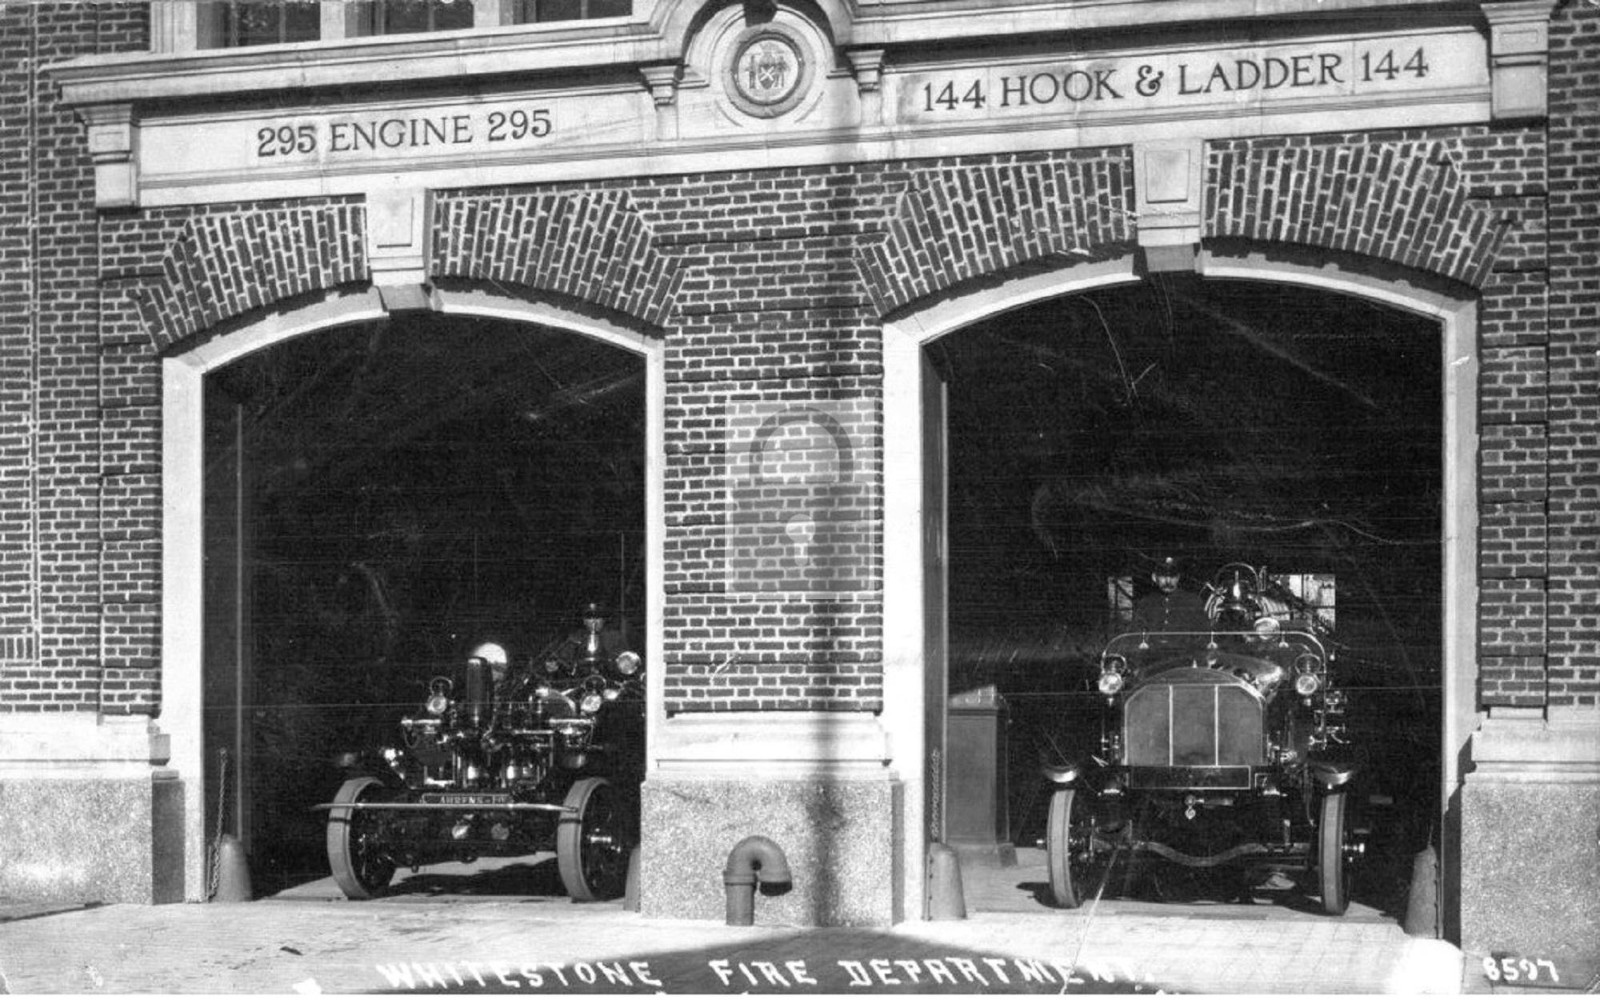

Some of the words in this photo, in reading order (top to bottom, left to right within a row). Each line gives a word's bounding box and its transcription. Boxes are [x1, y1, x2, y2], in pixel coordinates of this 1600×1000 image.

[923, 80, 986, 111] 144
[1000, 69, 1122, 106] HOOK
[1136, 65, 1164, 96] &
[1178, 54, 1344, 95] LADDER
[1361, 47, 1429, 82] 144
[257, 127, 317, 157] 295
[329, 116, 473, 152] ENGINE
[487, 109, 552, 141] 295
